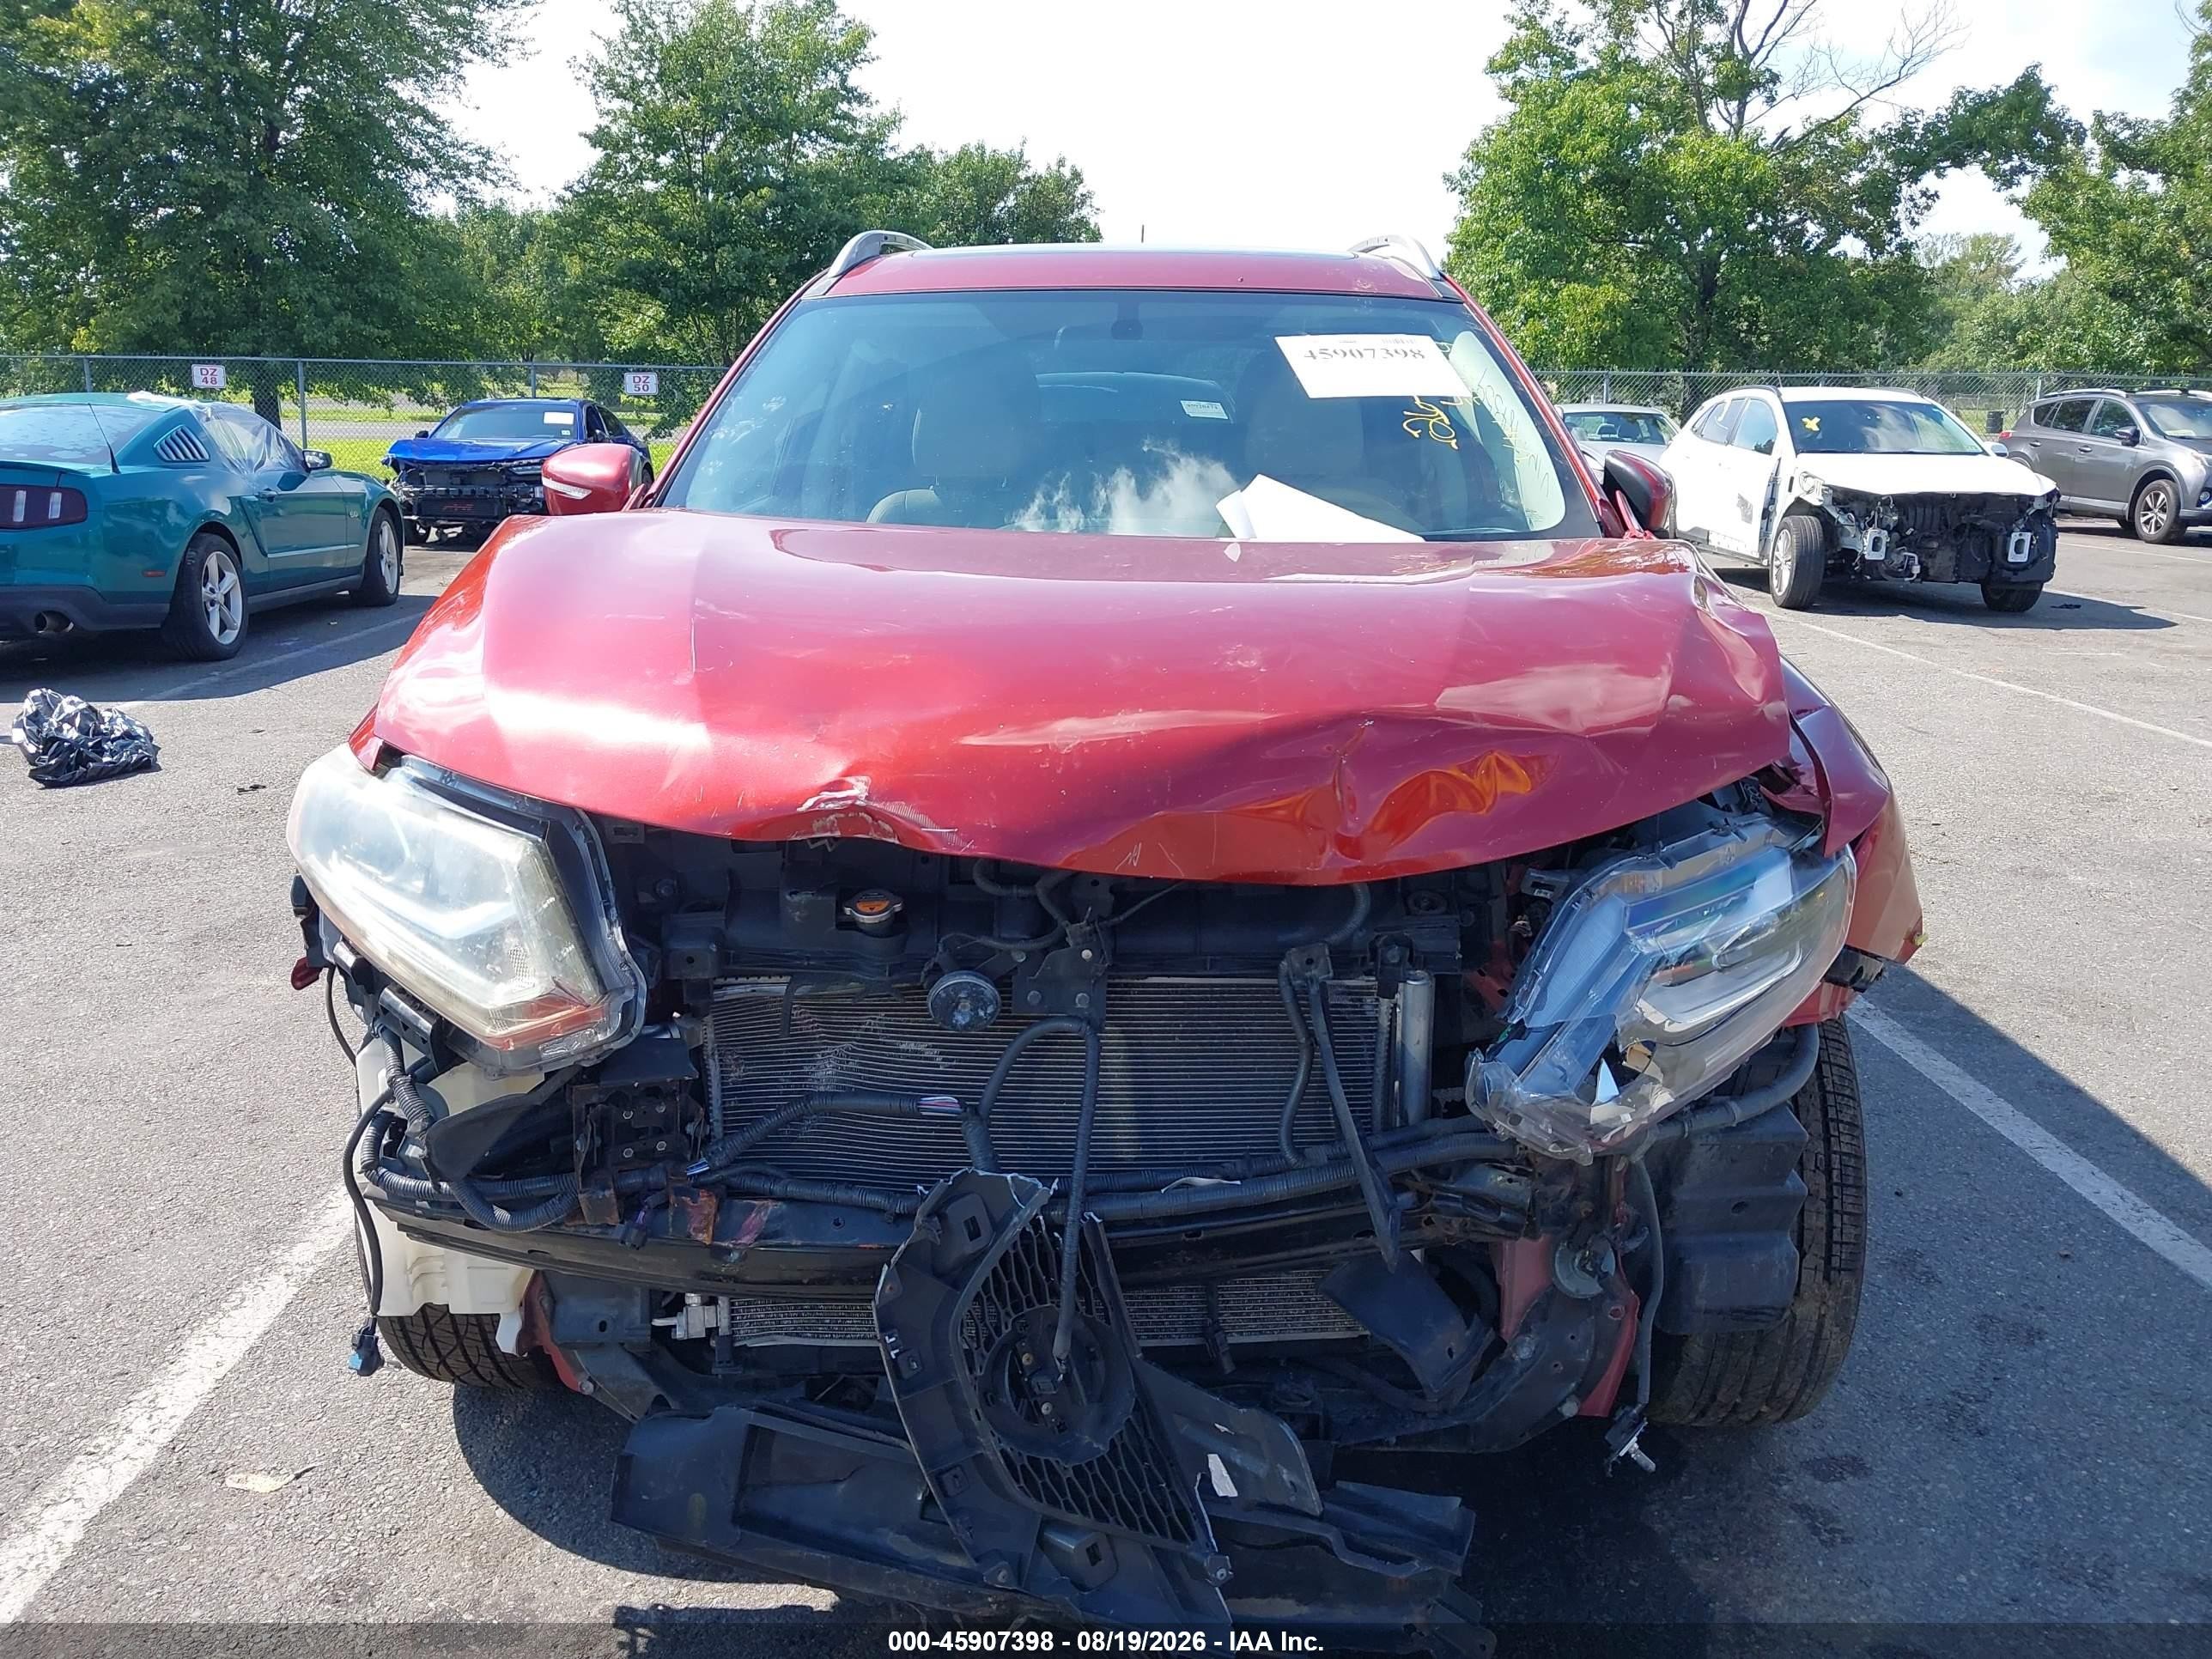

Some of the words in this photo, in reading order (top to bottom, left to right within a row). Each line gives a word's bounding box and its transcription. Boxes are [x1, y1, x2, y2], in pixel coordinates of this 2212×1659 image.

[1304, 347, 1426, 361] 45907398
[199, 368, 218, 376] DZ
[201, 376, 218, 385] 48
[632, 375, 650, 384] DZ
